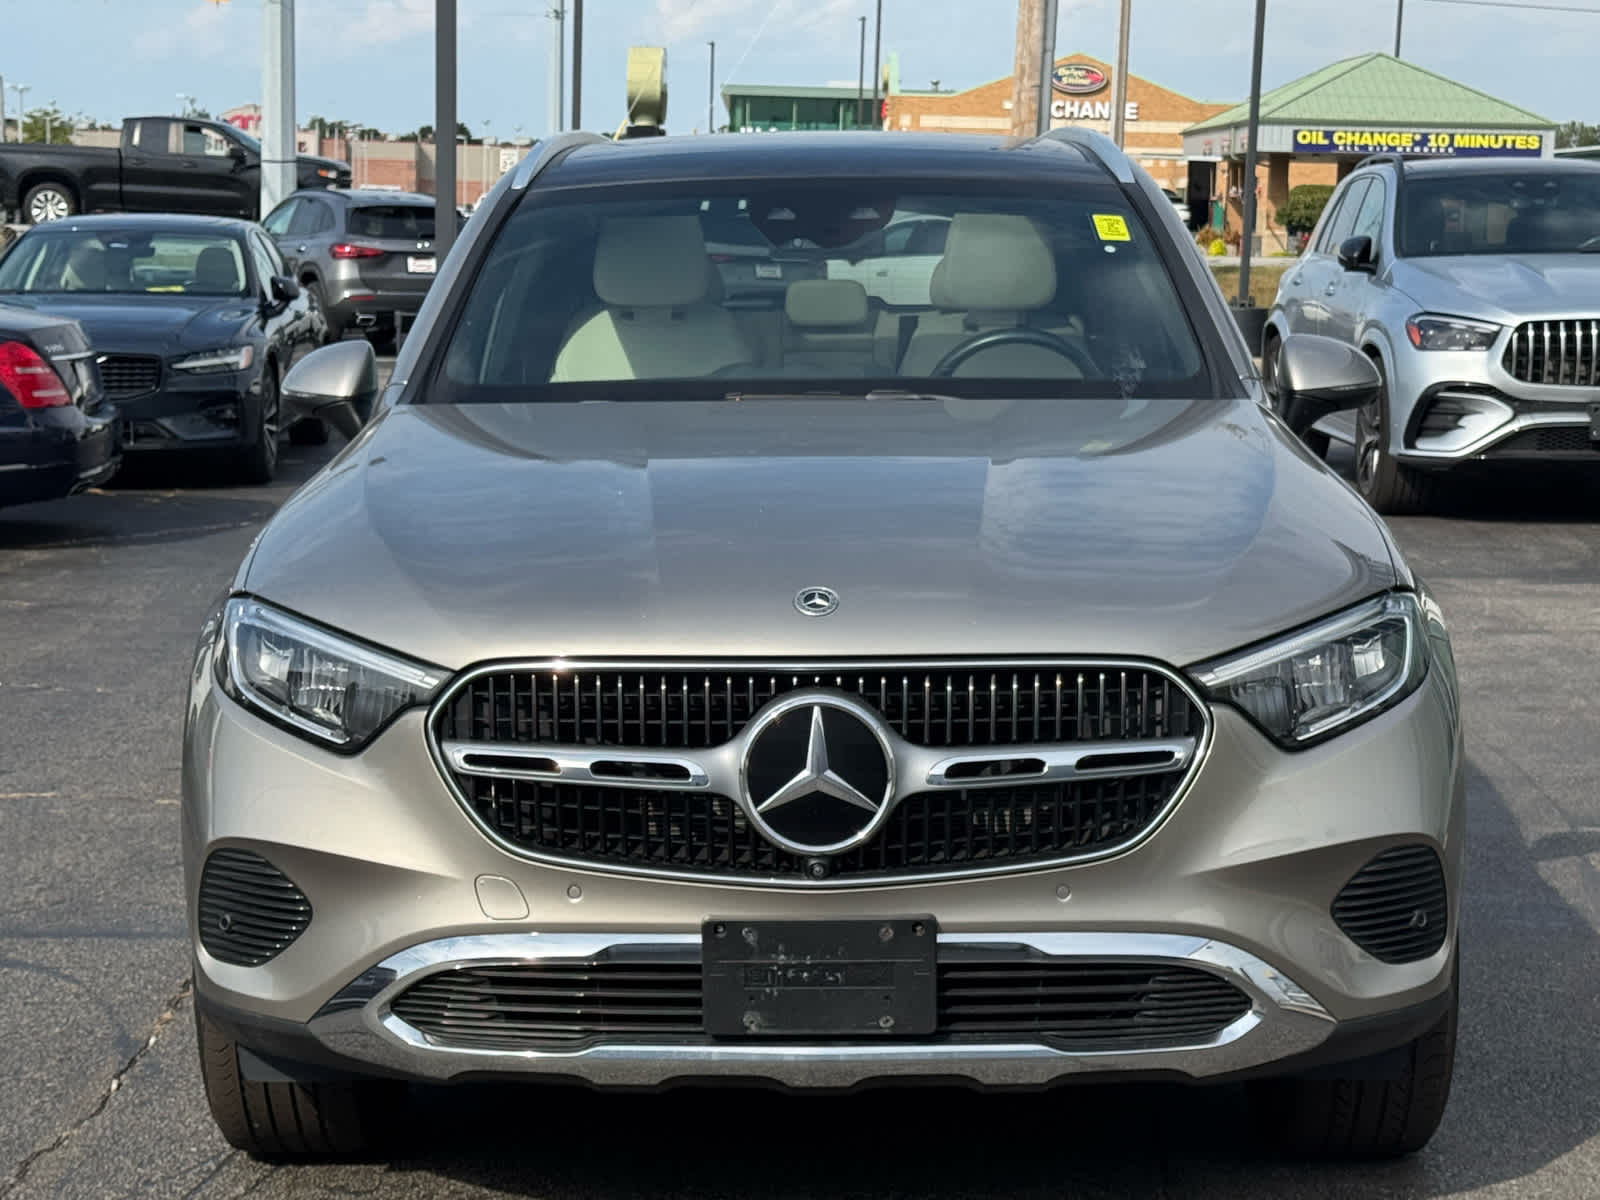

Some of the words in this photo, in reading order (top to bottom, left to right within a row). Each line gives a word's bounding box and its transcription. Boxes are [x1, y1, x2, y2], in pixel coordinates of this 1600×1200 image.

[1051, 101, 1139, 120] CHANE
[1297, 131, 1329, 145] OIL
[1427, 134, 1450, 148] 10
[1454, 134, 1540, 149] MINUTES
